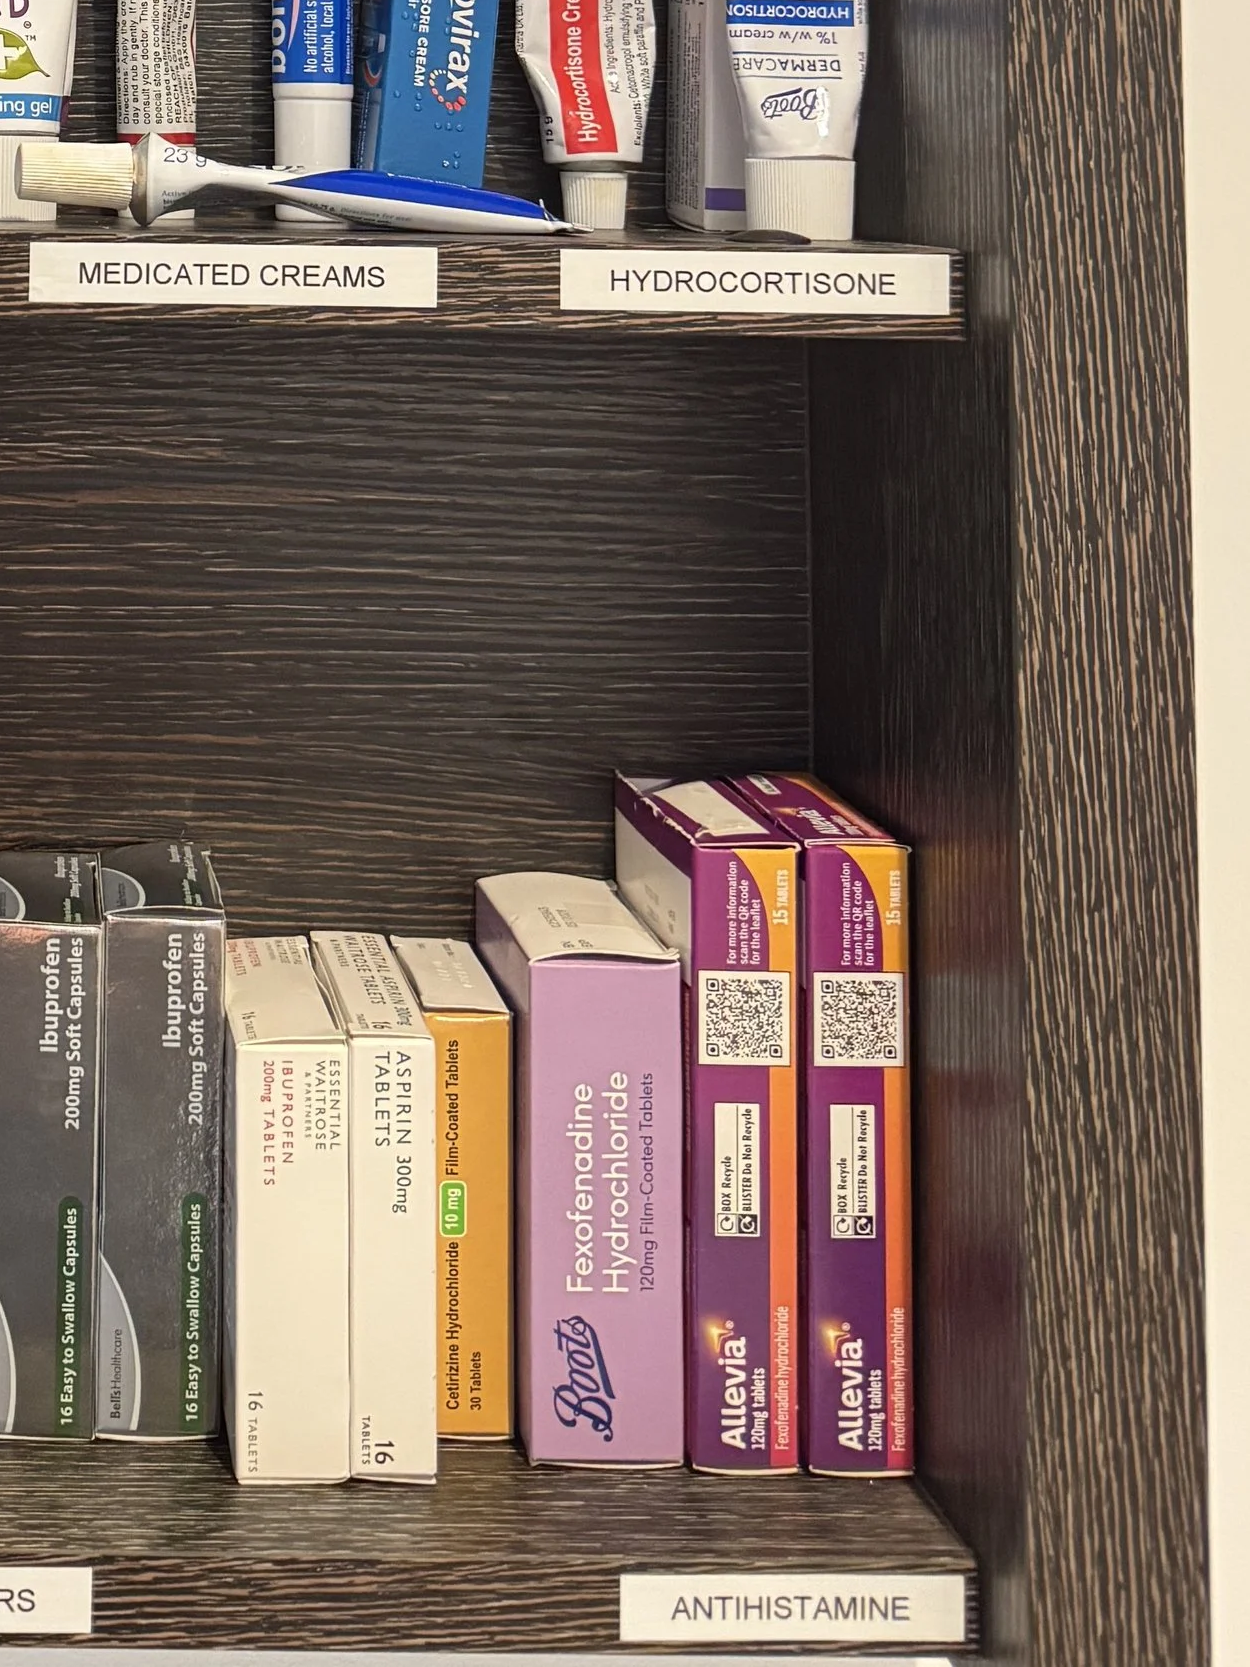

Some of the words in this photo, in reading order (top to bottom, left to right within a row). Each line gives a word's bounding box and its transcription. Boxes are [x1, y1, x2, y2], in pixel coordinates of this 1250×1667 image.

[320, 31, 336, 73] alcohol,
[413, 38, 429, 87] CREAM
[728, 29, 775, 39] cream
[733, 57, 842, 72] DERMACARE
[778, 31, 812, 43] w/w
[816, 31, 838, 45] 1%
[563, 26, 602, 143] Hydrocortisone
[78, 261, 250, 287] MEDICATED
[259, 264, 386, 289] CREAMS
[609, 269, 897, 295] HYDROCORTISONE
[39, 938, 64, 1053] Ibuprofen
[66, 937, 87, 1017] Capsules
[162, 933, 186, 1048] Ibuprofen
[65, 1023, 82, 1062] Soft
[445, 1039, 459, 1089] Tablets
[65, 1066, 85, 1130] 200mg
[281, 1060, 294, 1164] IBUPROFEN
[315, 1060, 327, 1150] WAITROSE
[329, 1060, 341, 1150] ESSENTIAL
[375, 1051, 391, 1148] TABLETS
[396, 1051, 412, 1144] ASPIRIN
[445, 1093, 459, 1176] Film-Coated
[392, 1156, 412, 1214] 300mg
[565, 1083, 594, 1293] Fexofenadine
[601, 1070, 638, 1294] Hydrochloride
[638, 1128, 655, 1235] Film-Coated
[63, 1207, 80, 1277] Capsules
[638, 1239, 659, 1292] 120mg
[61, 1279, 76, 1344] Swallow
[445, 1241, 462, 1340] Hydrochloride
[445, 1343, 460, 1410] Cetirizine
[774, 1306, 793, 1378] hydrochloride
[60, 1369, 77, 1403] Easy
[552, 1315, 616, 1443] Boots
[718, 1336, 747, 1450] Allevia
[750, 1367, 766, 1409] tablets
[834, 1338, 864, 1452] Allevia
[750, 1411, 769, 1451] 120mg
[774, 1380, 790, 1451] Fexofenadine
[670, 1596, 911, 1621] ANTIHISTAMINE
